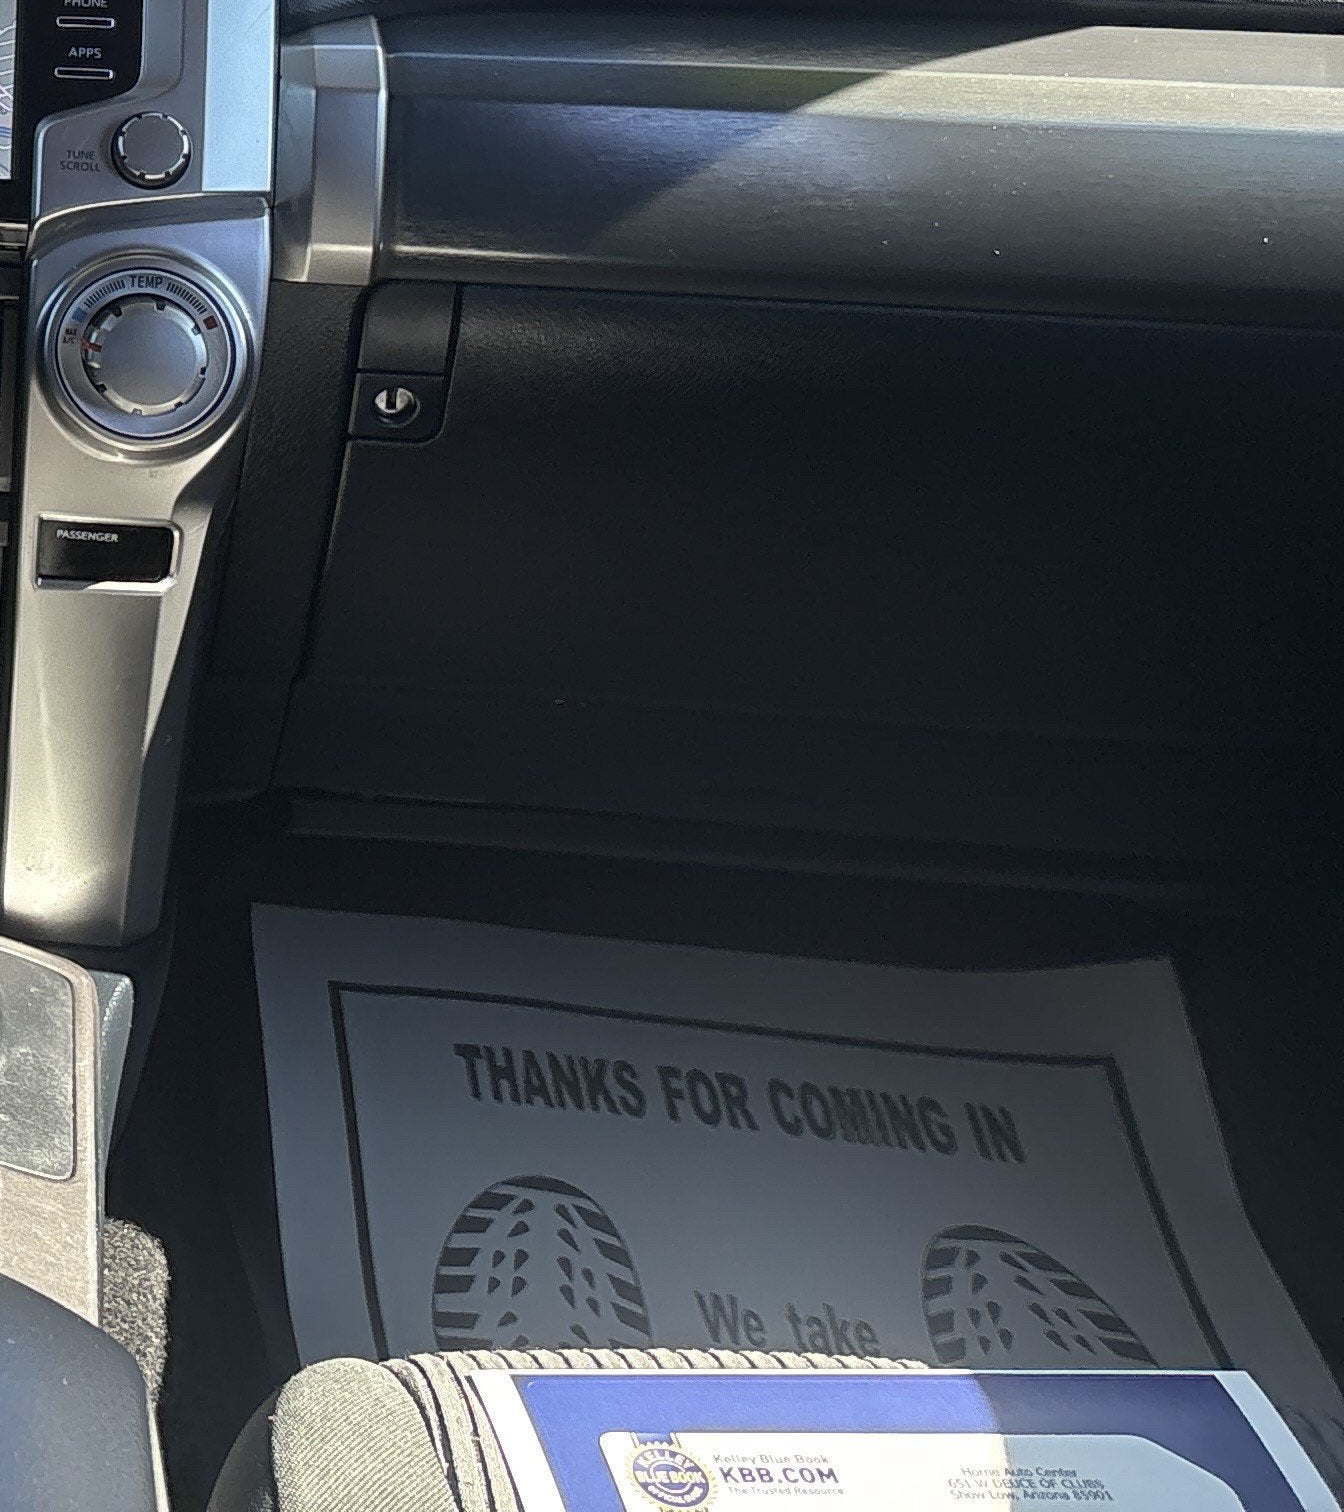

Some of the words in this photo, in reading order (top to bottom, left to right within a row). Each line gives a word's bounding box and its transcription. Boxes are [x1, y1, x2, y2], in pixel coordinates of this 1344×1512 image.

[68, 46, 102, 59] APPS
[67, 149, 96, 160] TUNE
[59, 159, 101, 173] SCROLL
[129, 275, 164, 289] TEMP
[56, 528, 119, 543] PASSENGER
[454, 1042, 646, 1119] THANKS
[655, 1064, 761, 1131] FOR
[766, 1077, 959, 1157] COMING
[963, 1101, 1026, 1164] IN
[693, 1288, 767, 1348] We
[785, 1302, 880, 1357] take
[635, 1449, 696, 1469] KELLEY
[713, 1453, 756, 1465] Kelley
[758, 1454, 791, 1464] Blue
[793, 1454, 830, 1464] Book
[636, 1471, 670, 1485] BLUE
[671, 1471, 707, 1485] BOOK
[718, 1466, 840, 1484] KBB.COM
[961, 1467, 1000, 1477] Horne
[1004, 1467, 1033, 1477] Auto
[1035, 1467, 1078, 1478] Center
[728, 1487, 750, 1495] The
[752, 1487, 791, 1495] Trusted
[794, 1487, 844, 1495] Resource
[948, 1478, 972, 1488] 651
[992, 1478, 1037, 1489] DEUCE
[1039, 1479, 1057, 1489] OF
[1061, 1479, 1105, 1490] CLUBS
[950, 1489, 986, 1500] Show
[988, 1490, 1020, 1501] Low,
[1023, 1490, 1071, 1501] Arizona
[1072, 1490, 1113, 1502] 85901
